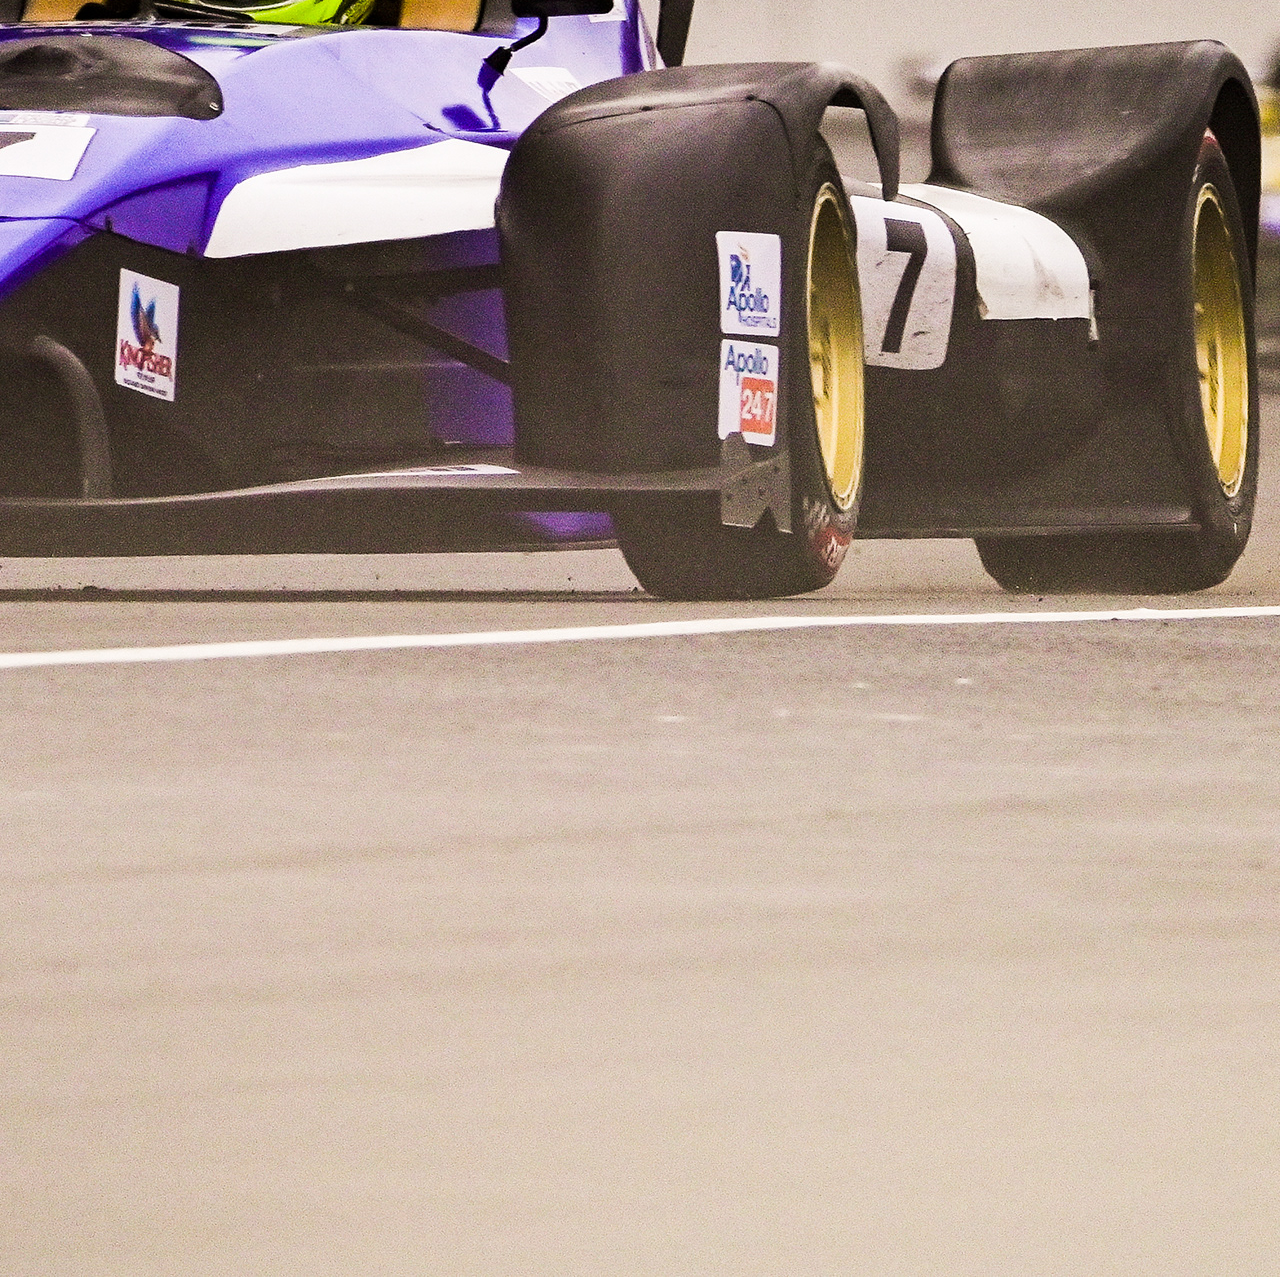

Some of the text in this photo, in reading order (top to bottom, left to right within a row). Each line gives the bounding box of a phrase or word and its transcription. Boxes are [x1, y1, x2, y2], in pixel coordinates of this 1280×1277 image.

[726, 286, 770, 322] Apollo
[882, 217, 928, 354] 7
[724, 345, 769, 386] Apollo
